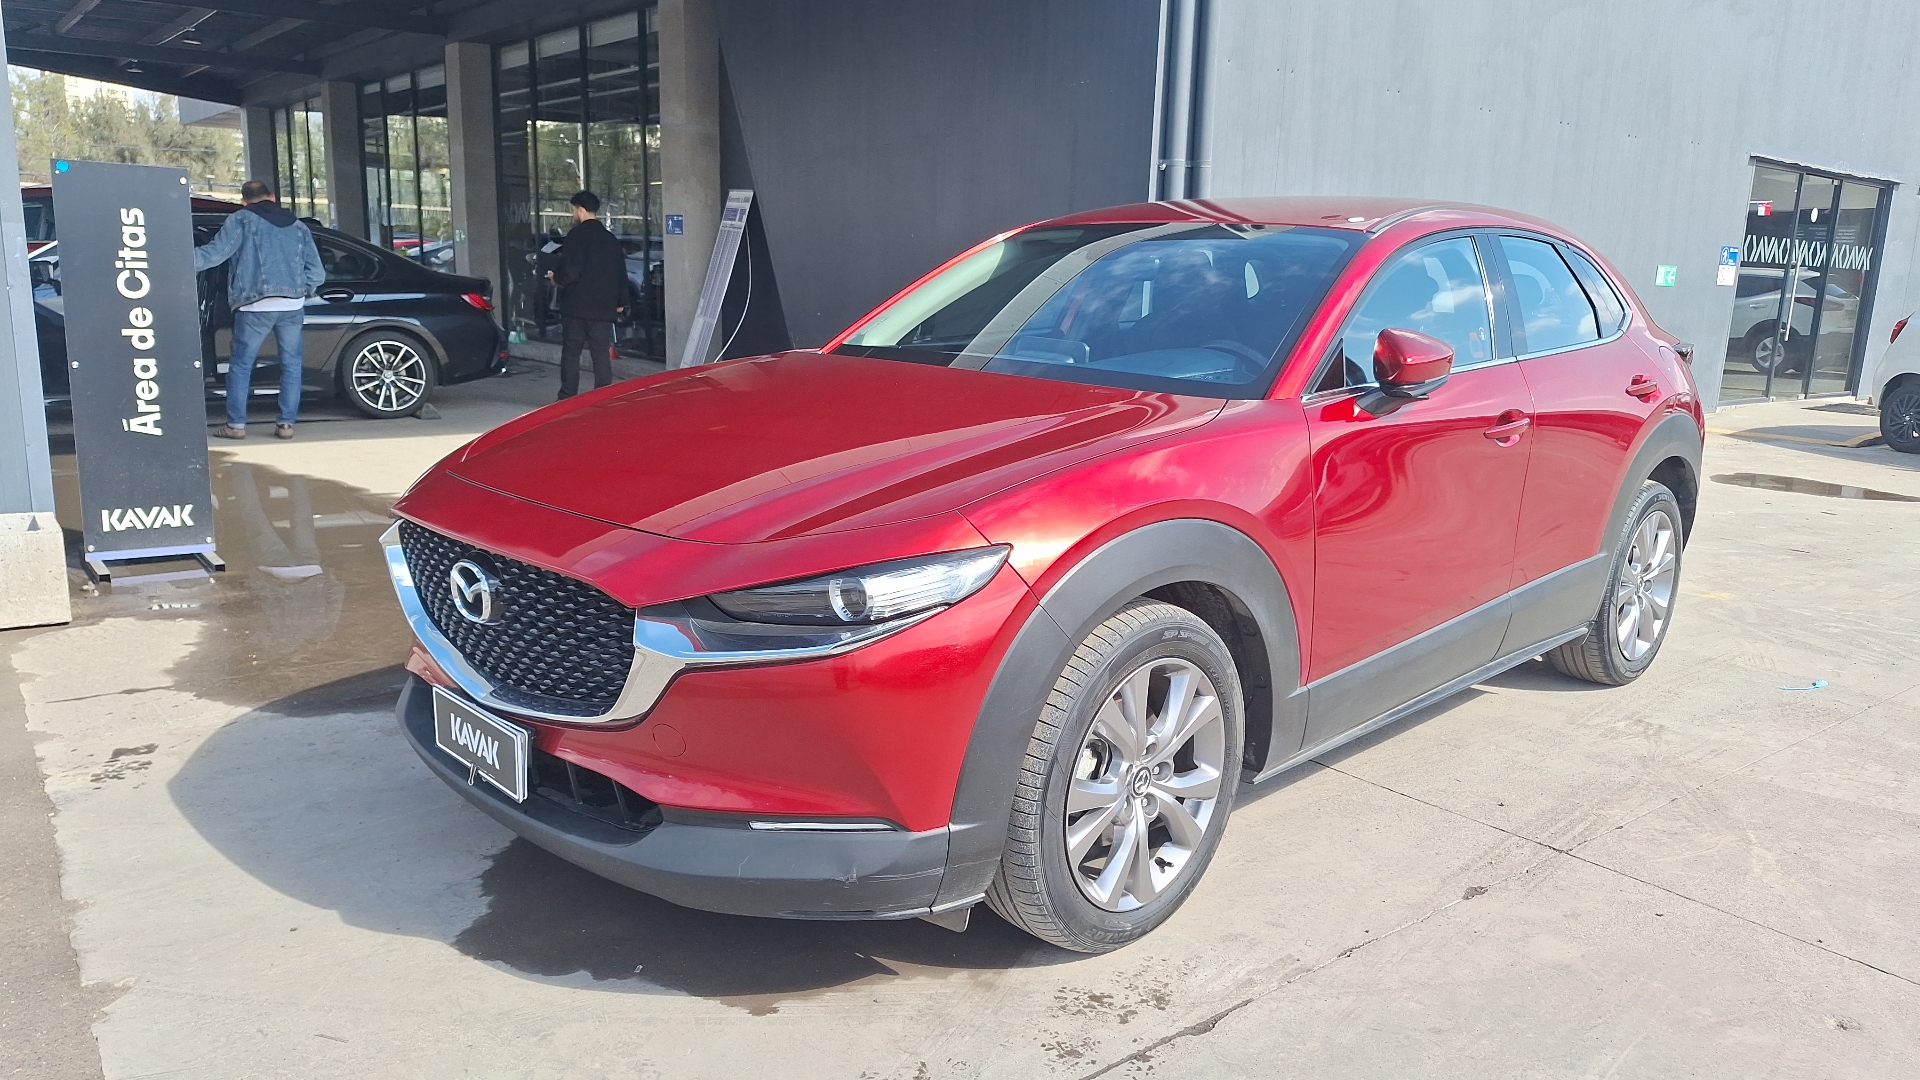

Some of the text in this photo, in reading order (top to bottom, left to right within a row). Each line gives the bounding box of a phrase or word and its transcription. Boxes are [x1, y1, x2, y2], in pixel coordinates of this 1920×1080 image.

[115, 207, 163, 436] Área de Citas
[101, 504, 195, 532] KAVAK
[450, 712, 500, 770] KAVAK
